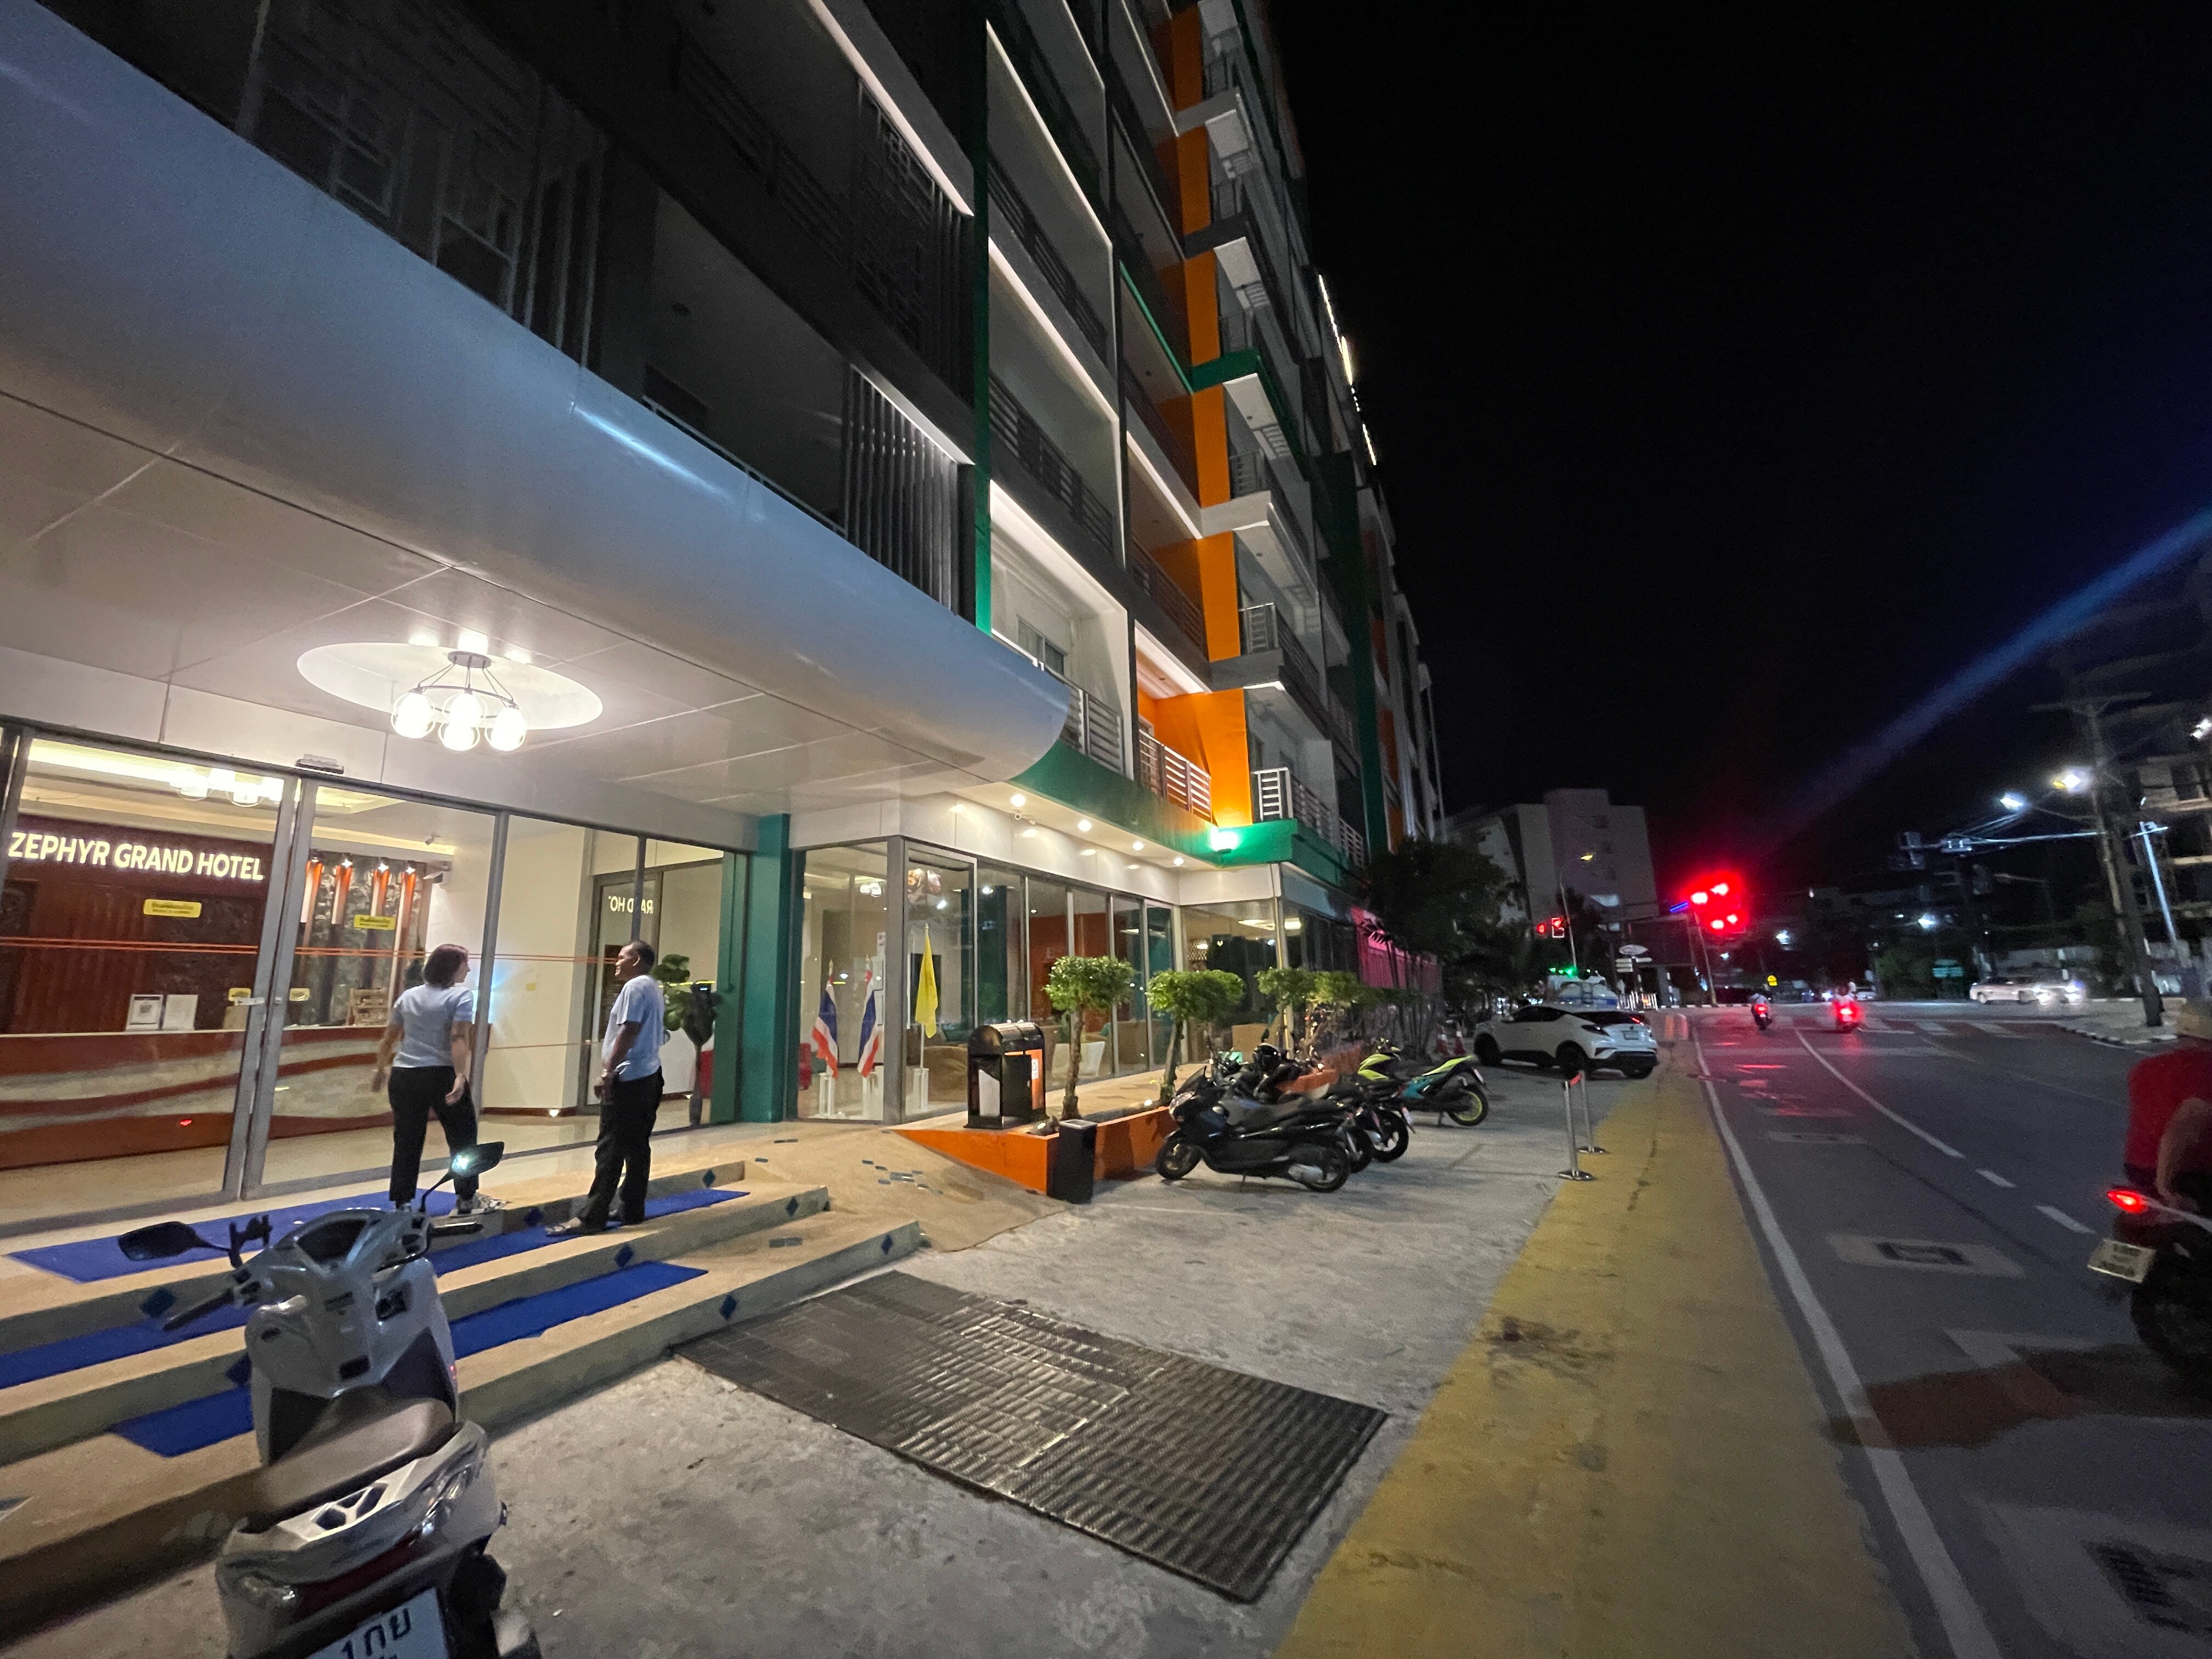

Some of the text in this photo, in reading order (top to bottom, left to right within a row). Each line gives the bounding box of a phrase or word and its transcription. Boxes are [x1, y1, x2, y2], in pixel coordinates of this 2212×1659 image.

[8, 832, 263, 881] ZEPHYR GRAND HOTEL
